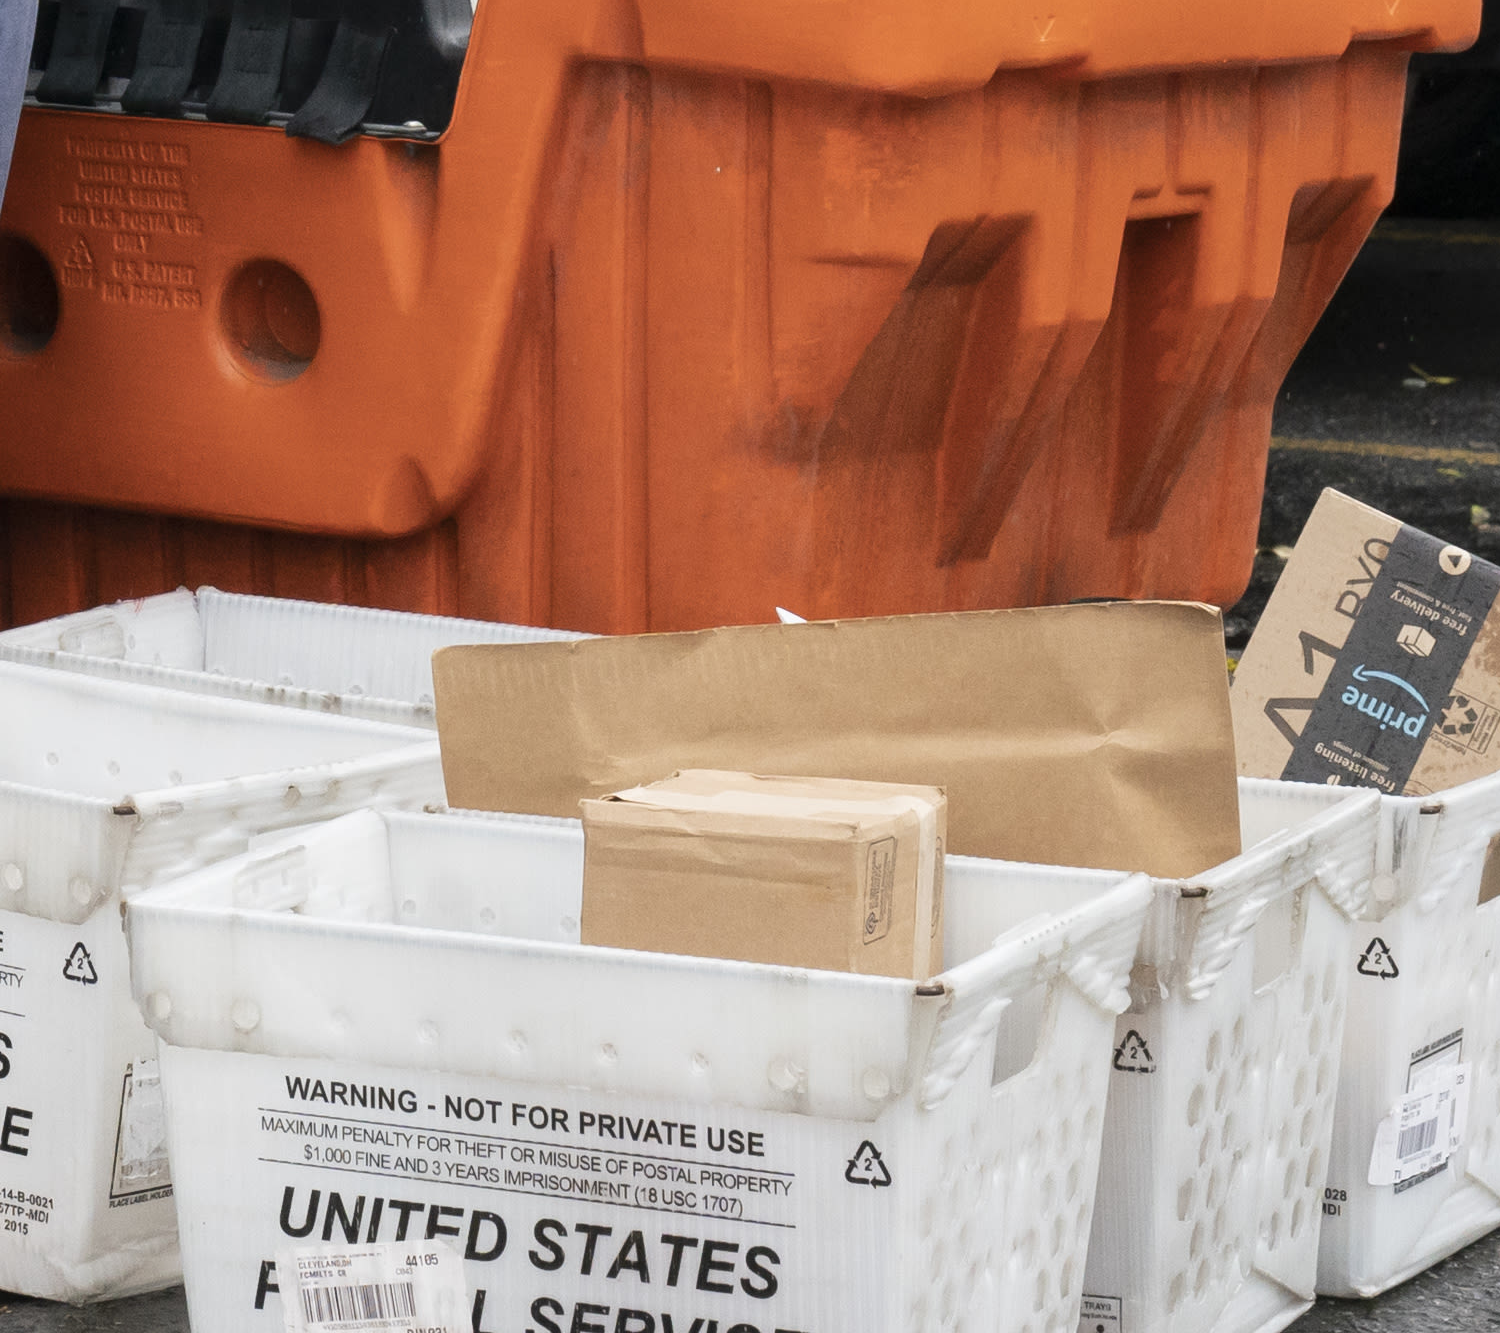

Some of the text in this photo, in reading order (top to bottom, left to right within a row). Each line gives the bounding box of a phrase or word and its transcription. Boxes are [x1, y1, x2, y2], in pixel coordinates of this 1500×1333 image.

[1389, 589, 1469, 637] free delivery
[1341, 684, 1427, 738] prime
[1314, 742, 1396, 793] free listening
[285, 1075, 418, 1113] WARNING
[444, 1094, 502, 1124] NOT
[511, 1102, 570, 1133] FOR
[579, 1111, 697, 1148] PRIVATE
[708, 1127, 765, 1157] USE
[261, 1115, 792, 1197] MAXIMUM PENALTY FOR THEFT OR MISUSE OF POSTAL PROPERTY
[304, 1144, 743, 1217] $1,000 FINE AND 3 YEARS IMPRISONMENT (18 USC 1707)
[4, 1219, 28, 1235] 2015
[279, 1186, 508, 1262] UNITED
[528, 1217, 782, 1300] STATES
[406, 1254, 438, 1267] 44105
